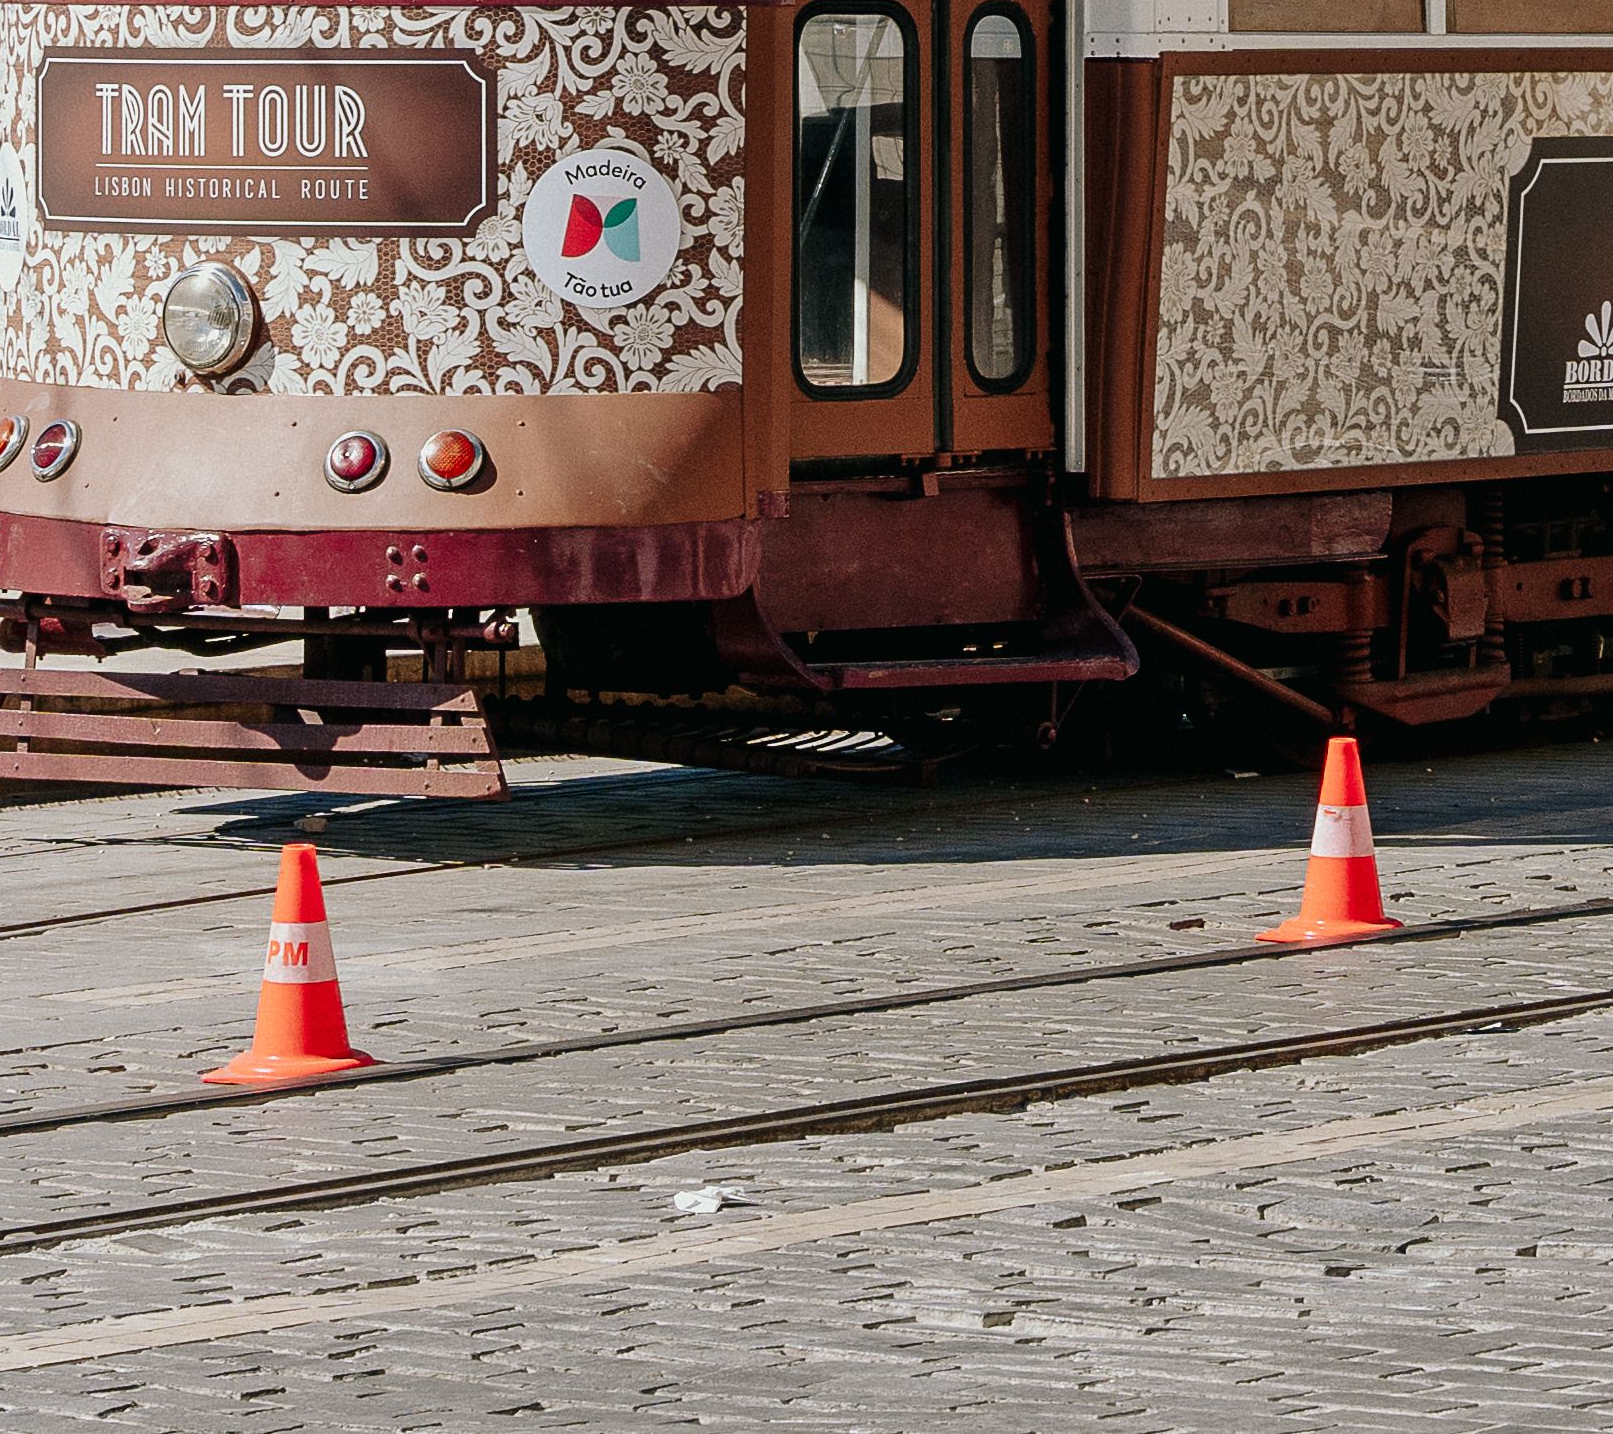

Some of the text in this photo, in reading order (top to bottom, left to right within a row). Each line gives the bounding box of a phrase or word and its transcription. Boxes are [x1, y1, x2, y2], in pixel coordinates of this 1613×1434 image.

[95, 83, 369, 158] TRAM TOUR
[95, 176, 369, 200] LISBON HISTORICAL ROUTE
[564, 159, 647, 190] Madeira
[564, 271, 634, 298] Tão tua
[268, 939, 309, 967] PM
